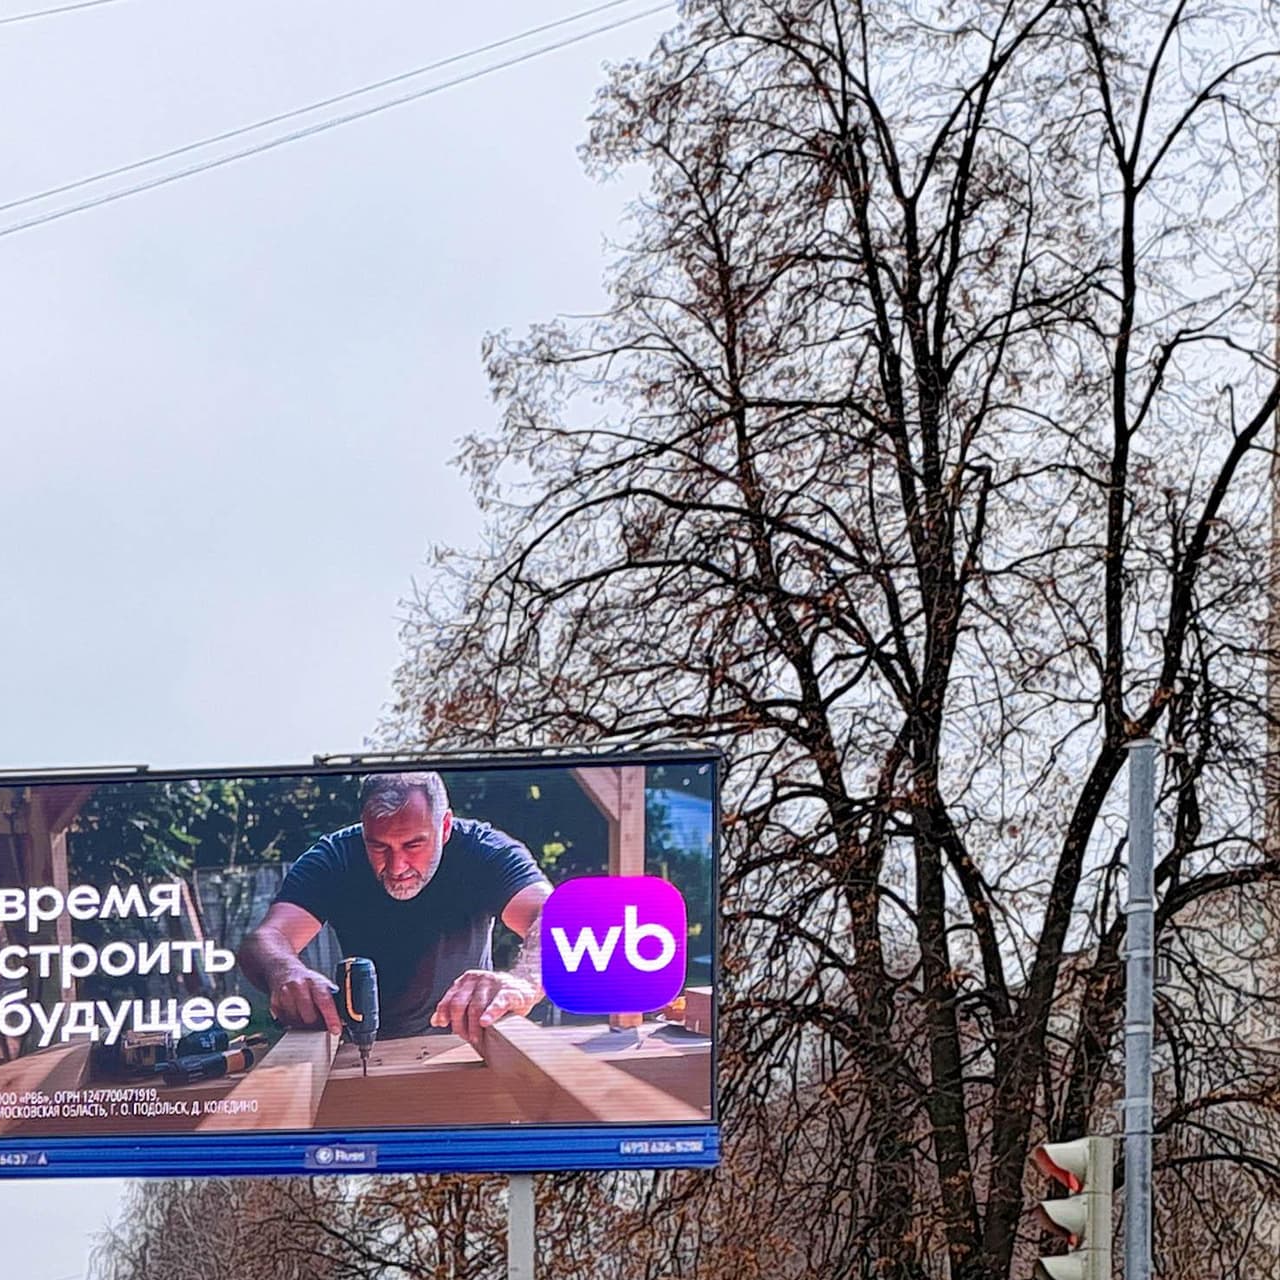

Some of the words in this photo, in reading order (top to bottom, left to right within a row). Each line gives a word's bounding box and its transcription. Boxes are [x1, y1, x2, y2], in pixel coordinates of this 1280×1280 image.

[550, 905, 676, 972] wb
[54, 1090, 80, 1104] ОГРН
[62, 1103, 108, 1118] ОБЛАСТЬ,
[133, 1101, 189, 1117] ПОДОЛЬСК,
[204, 1099, 258, 1114] КОЛЕДИНО
